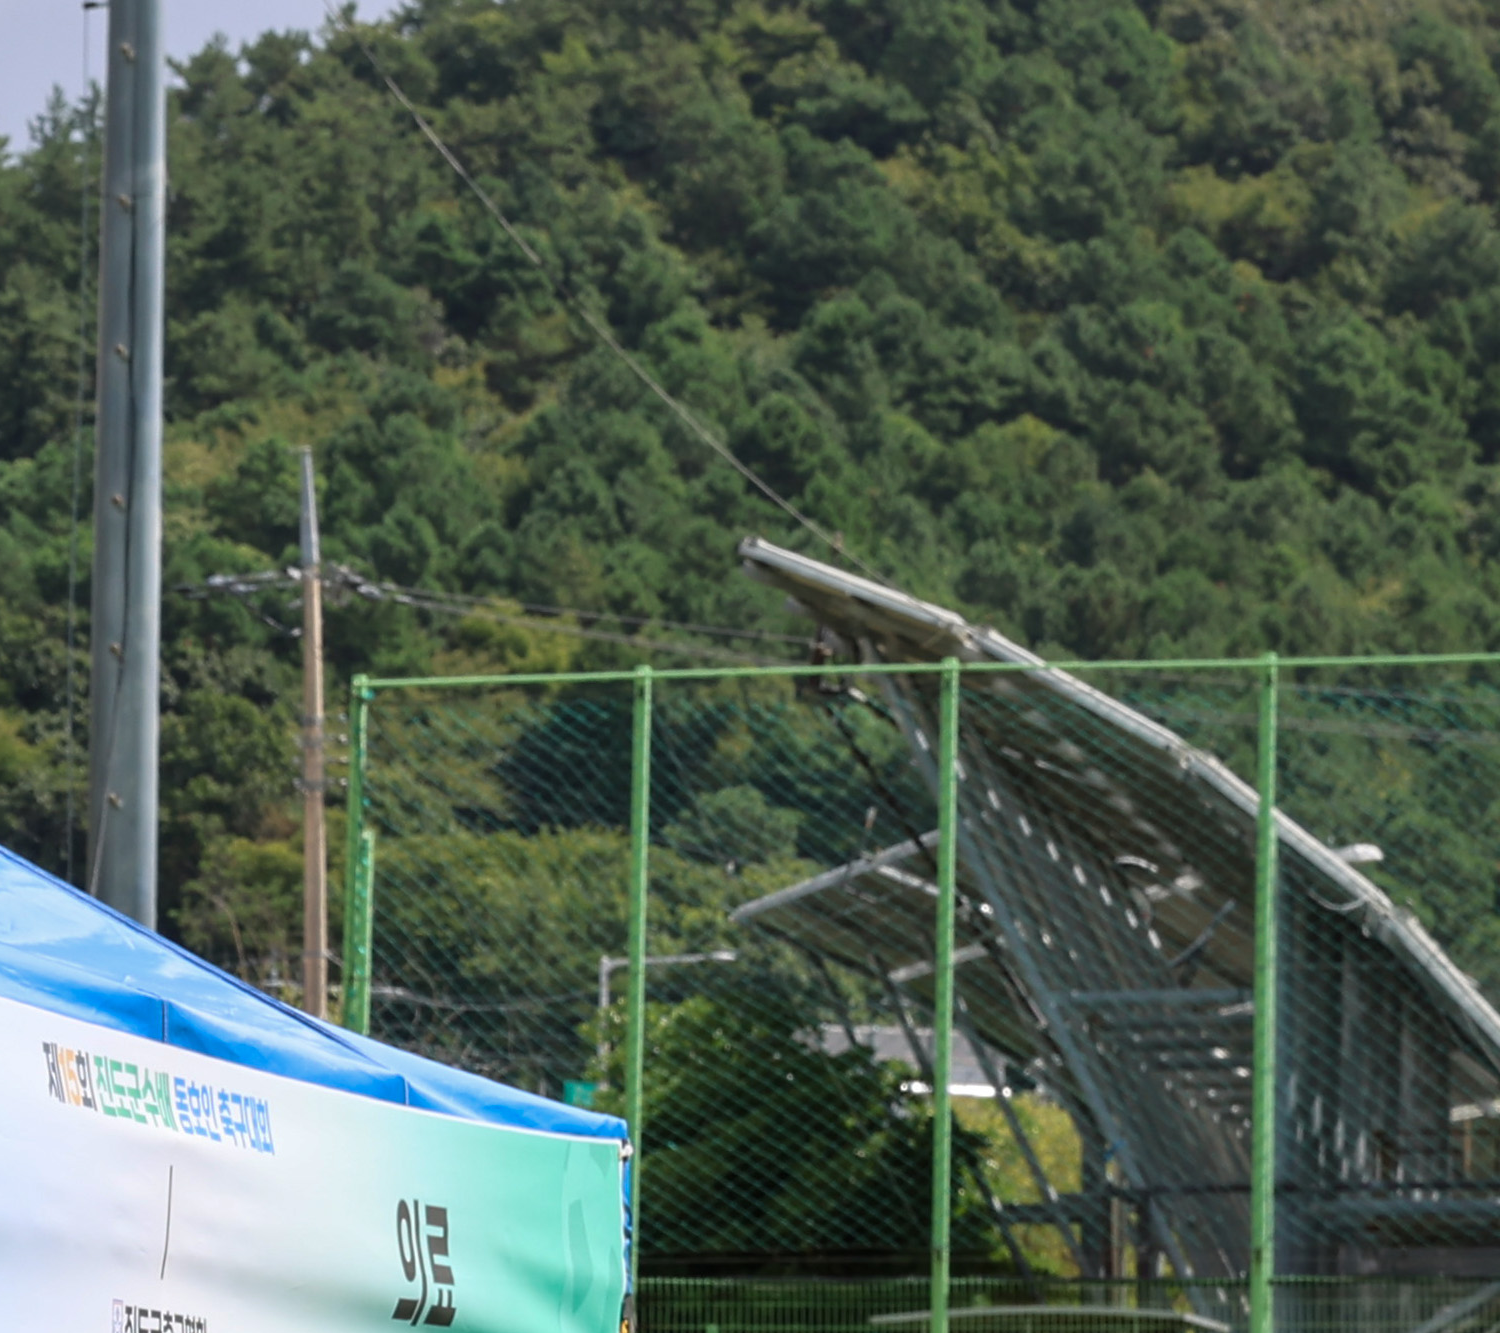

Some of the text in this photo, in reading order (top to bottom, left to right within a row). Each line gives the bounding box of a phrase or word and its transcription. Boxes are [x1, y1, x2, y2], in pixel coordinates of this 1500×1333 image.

[42, 1041, 275, 1156] 제15회 진도군수배 동호인 축구대회
[391, 1198, 457, 1327] 의료
